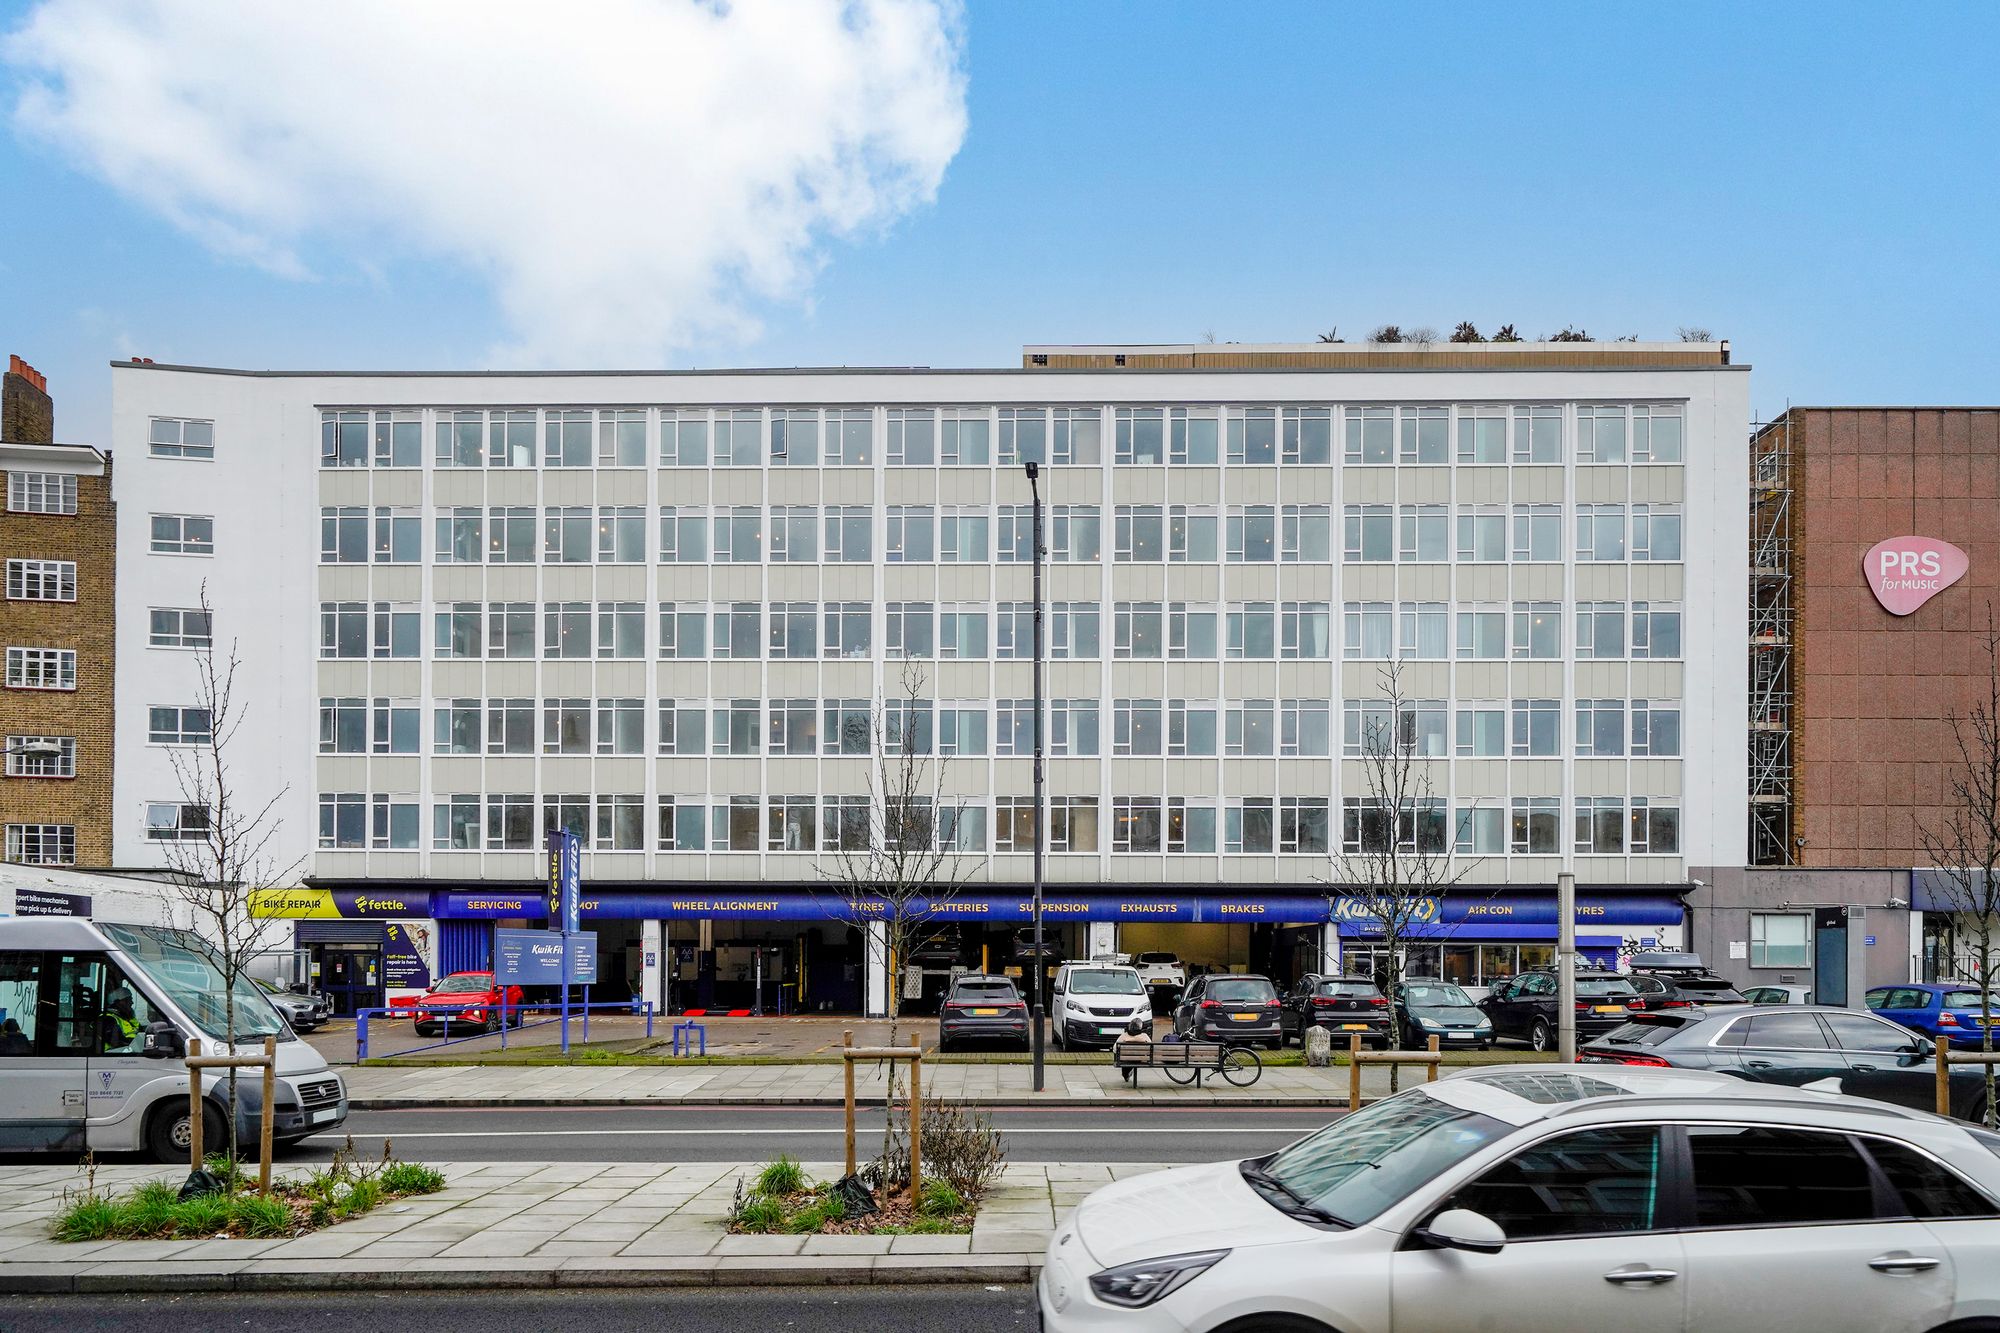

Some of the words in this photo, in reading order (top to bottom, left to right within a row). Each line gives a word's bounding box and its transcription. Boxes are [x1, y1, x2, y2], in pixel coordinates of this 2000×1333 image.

[1880, 550, 1941, 577] PRS
[1880, 577, 1900, 593] for
[1901, 579, 1939, 590] MUSIC
[41, 897, 69, 905] mechanics
[263, 900, 285, 909] BIKE
[287, 900, 321, 909] REPAIR
[368, 899, 407, 910] fettle.
[467, 901, 522, 910] SERVICING
[672, 901, 711, 911] WHEEL
[712, 901, 779, 911] ALIGNMENT
[28, 905, 40, 914] pick
[40, 907, 47, 915] up
[52, 908, 72, 916] delivery
[849, 902, 885, 912] TYRES
[931, 903, 989, 913] BATTERIES
[1019, 903, 1089, 912] SUPENSION
[1120, 904, 1178, 913] EXHAUSTS
[1220, 904, 1265, 914] BRAKES
[1468, 906, 1487, 915] AIR
[1489, 906, 1513, 915] CON
[1575, 906, 1605, 915] YRES
[532, 944, 554, 954] Kwik
